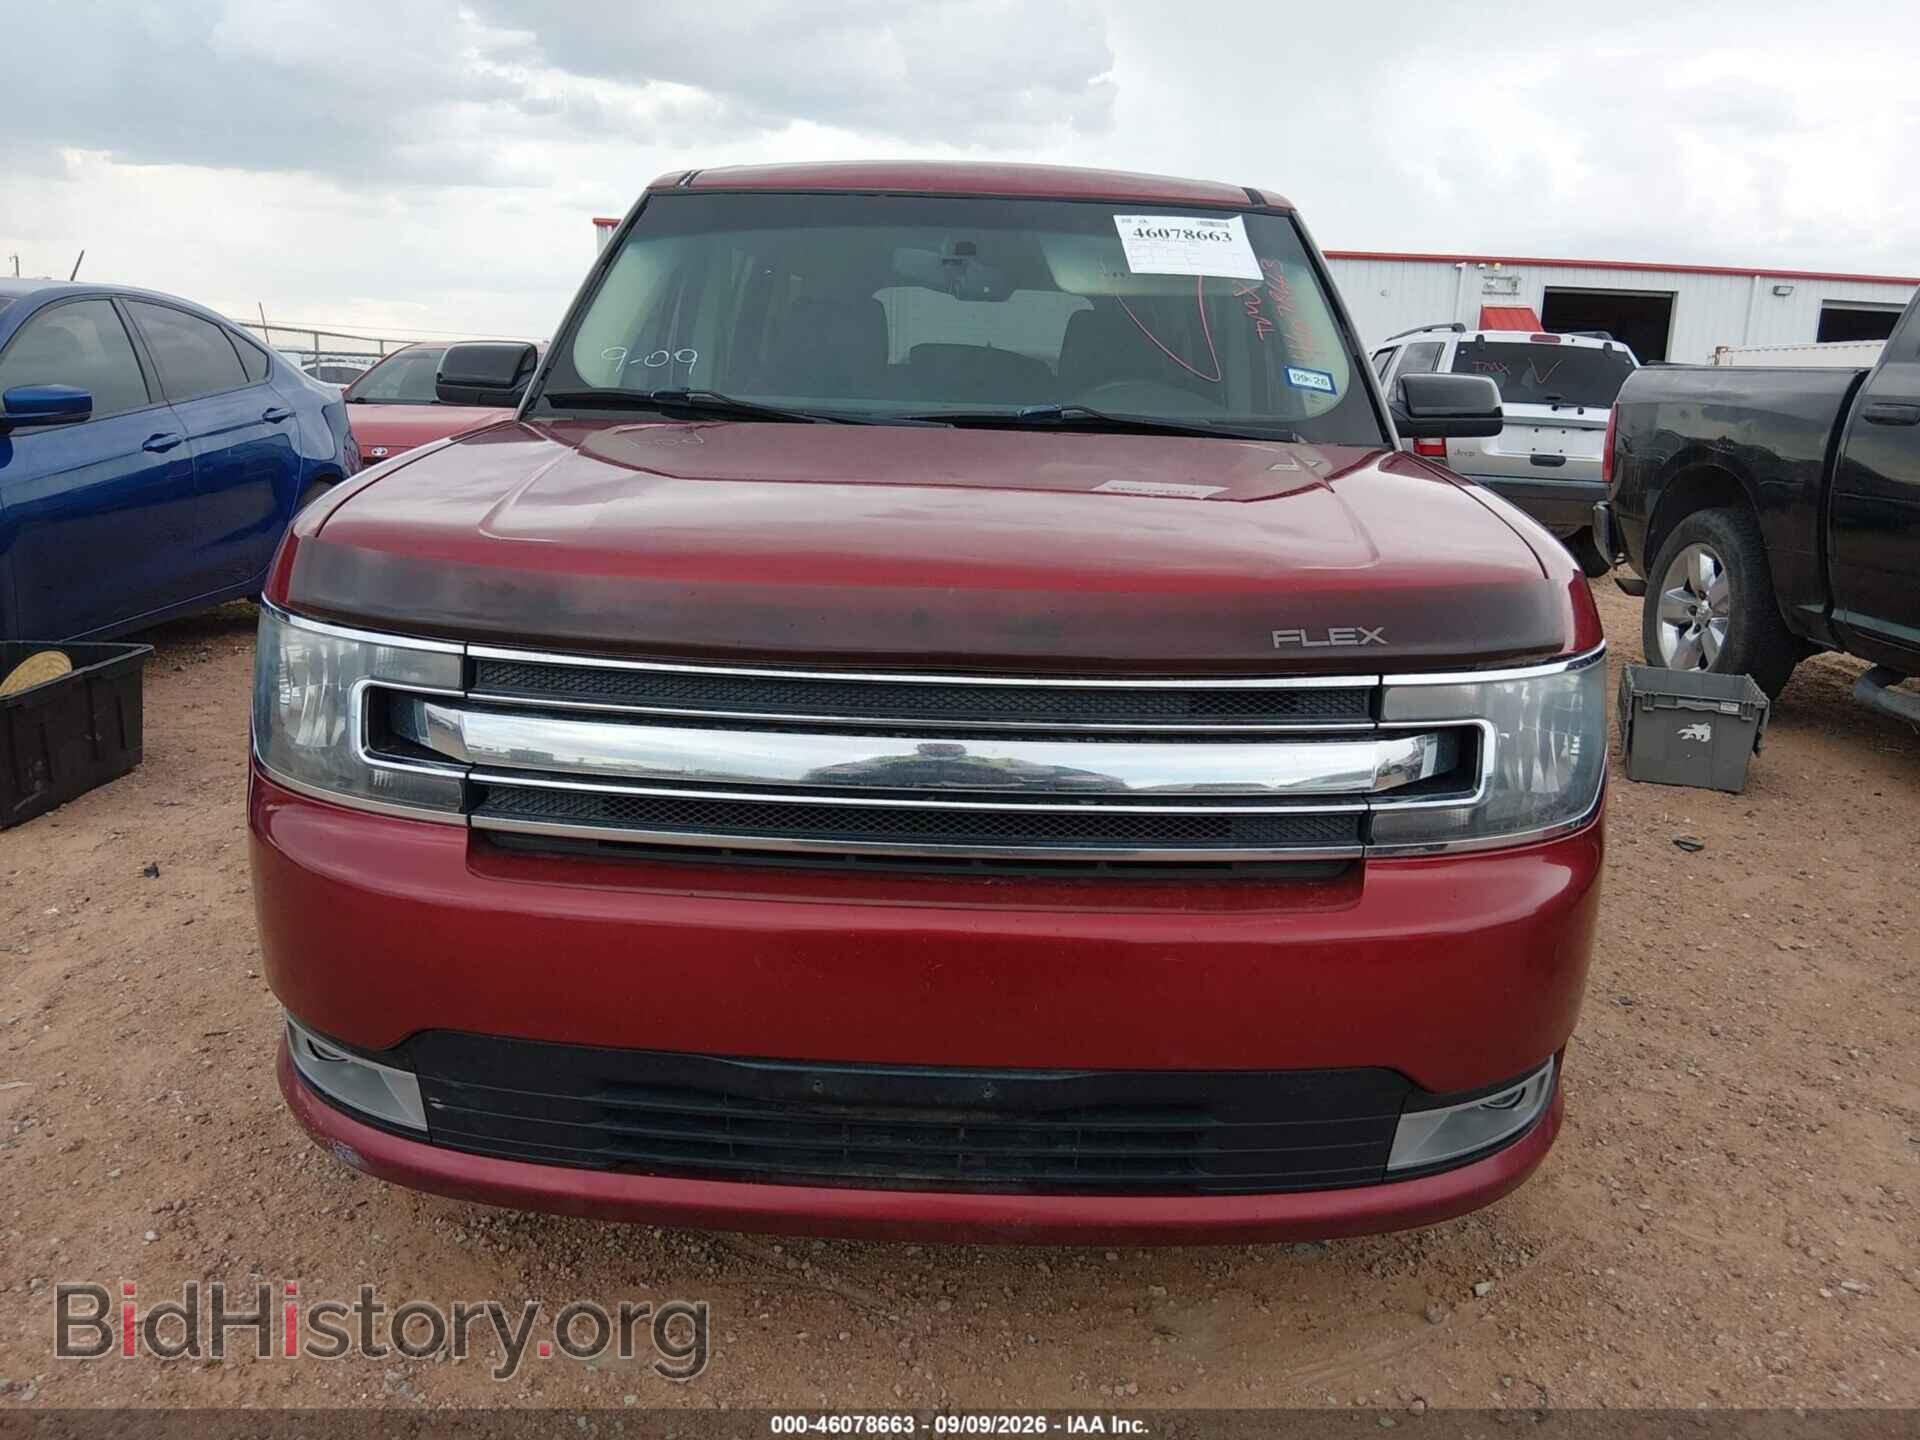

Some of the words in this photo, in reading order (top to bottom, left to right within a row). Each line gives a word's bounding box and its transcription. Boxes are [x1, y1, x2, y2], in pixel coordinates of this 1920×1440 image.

[1132, 227, 1233, 243] 46078663
[601, 346, 698, 375] 9-09
[1272, 626, 1389, 648] FLEX
